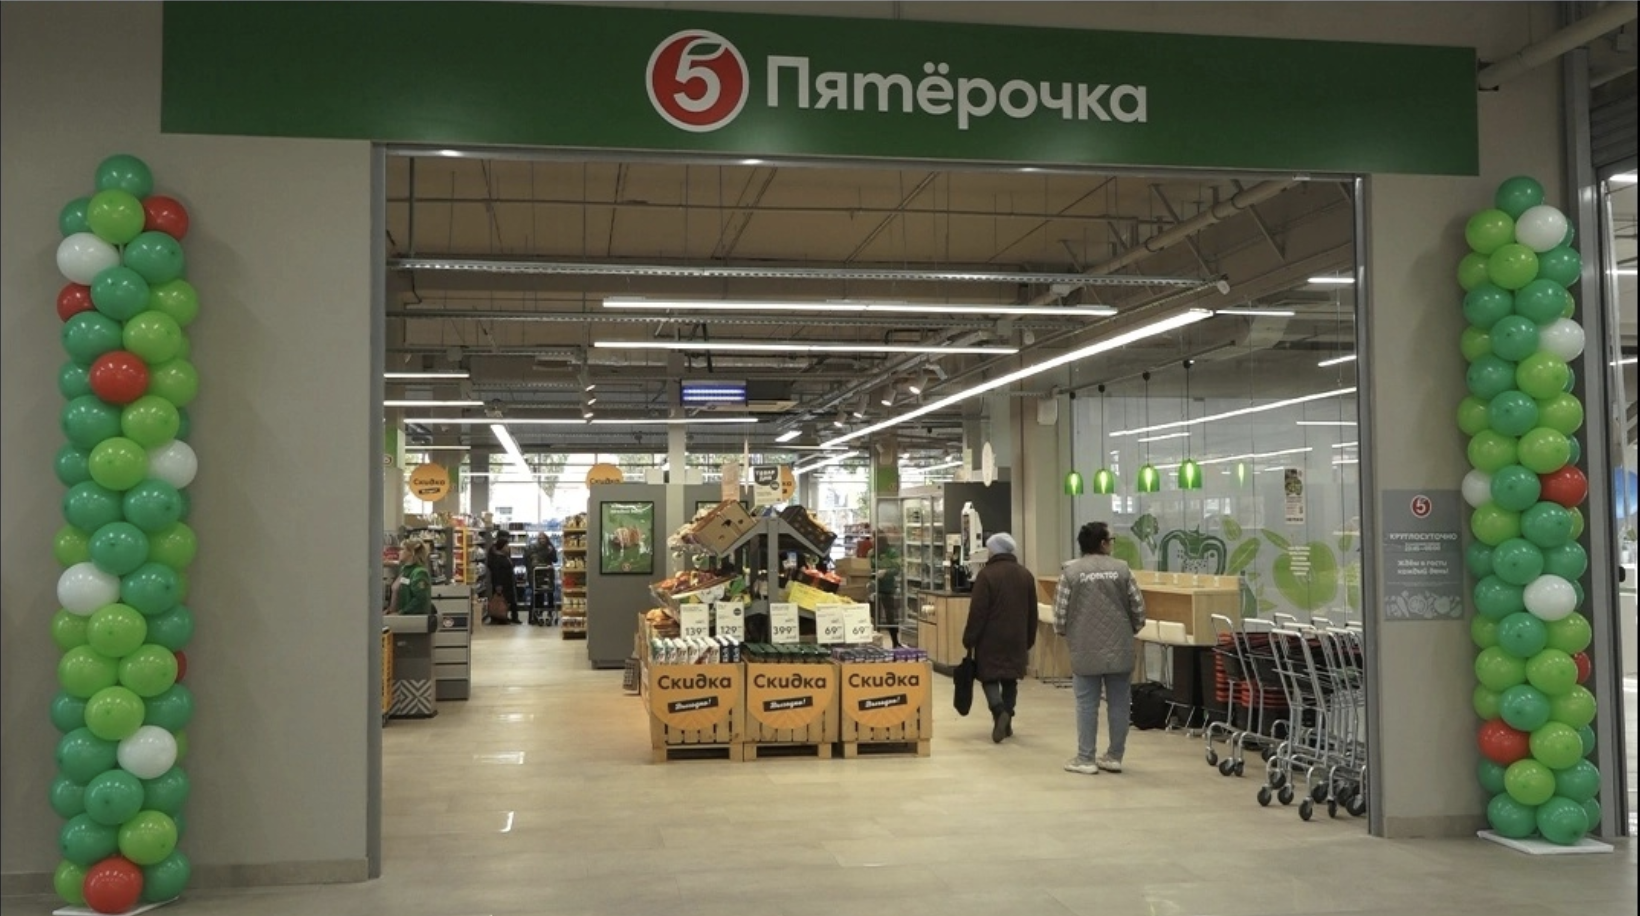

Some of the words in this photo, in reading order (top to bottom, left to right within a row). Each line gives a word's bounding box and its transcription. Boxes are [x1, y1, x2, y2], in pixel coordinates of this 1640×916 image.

[766, 55, 1147, 130] Пятёрочка
[685, 627, 702, 636] 139
[720, 625, 737, 634] 129
[773, 626, 793, 635] 399
[825, 626, 838, 635] 69
[852, 626, 866, 635] 69
[657, 673, 732, 690] Скидка
[753, 673, 827, 689] Скидка
[848, 671, 920, 688] Скидка
